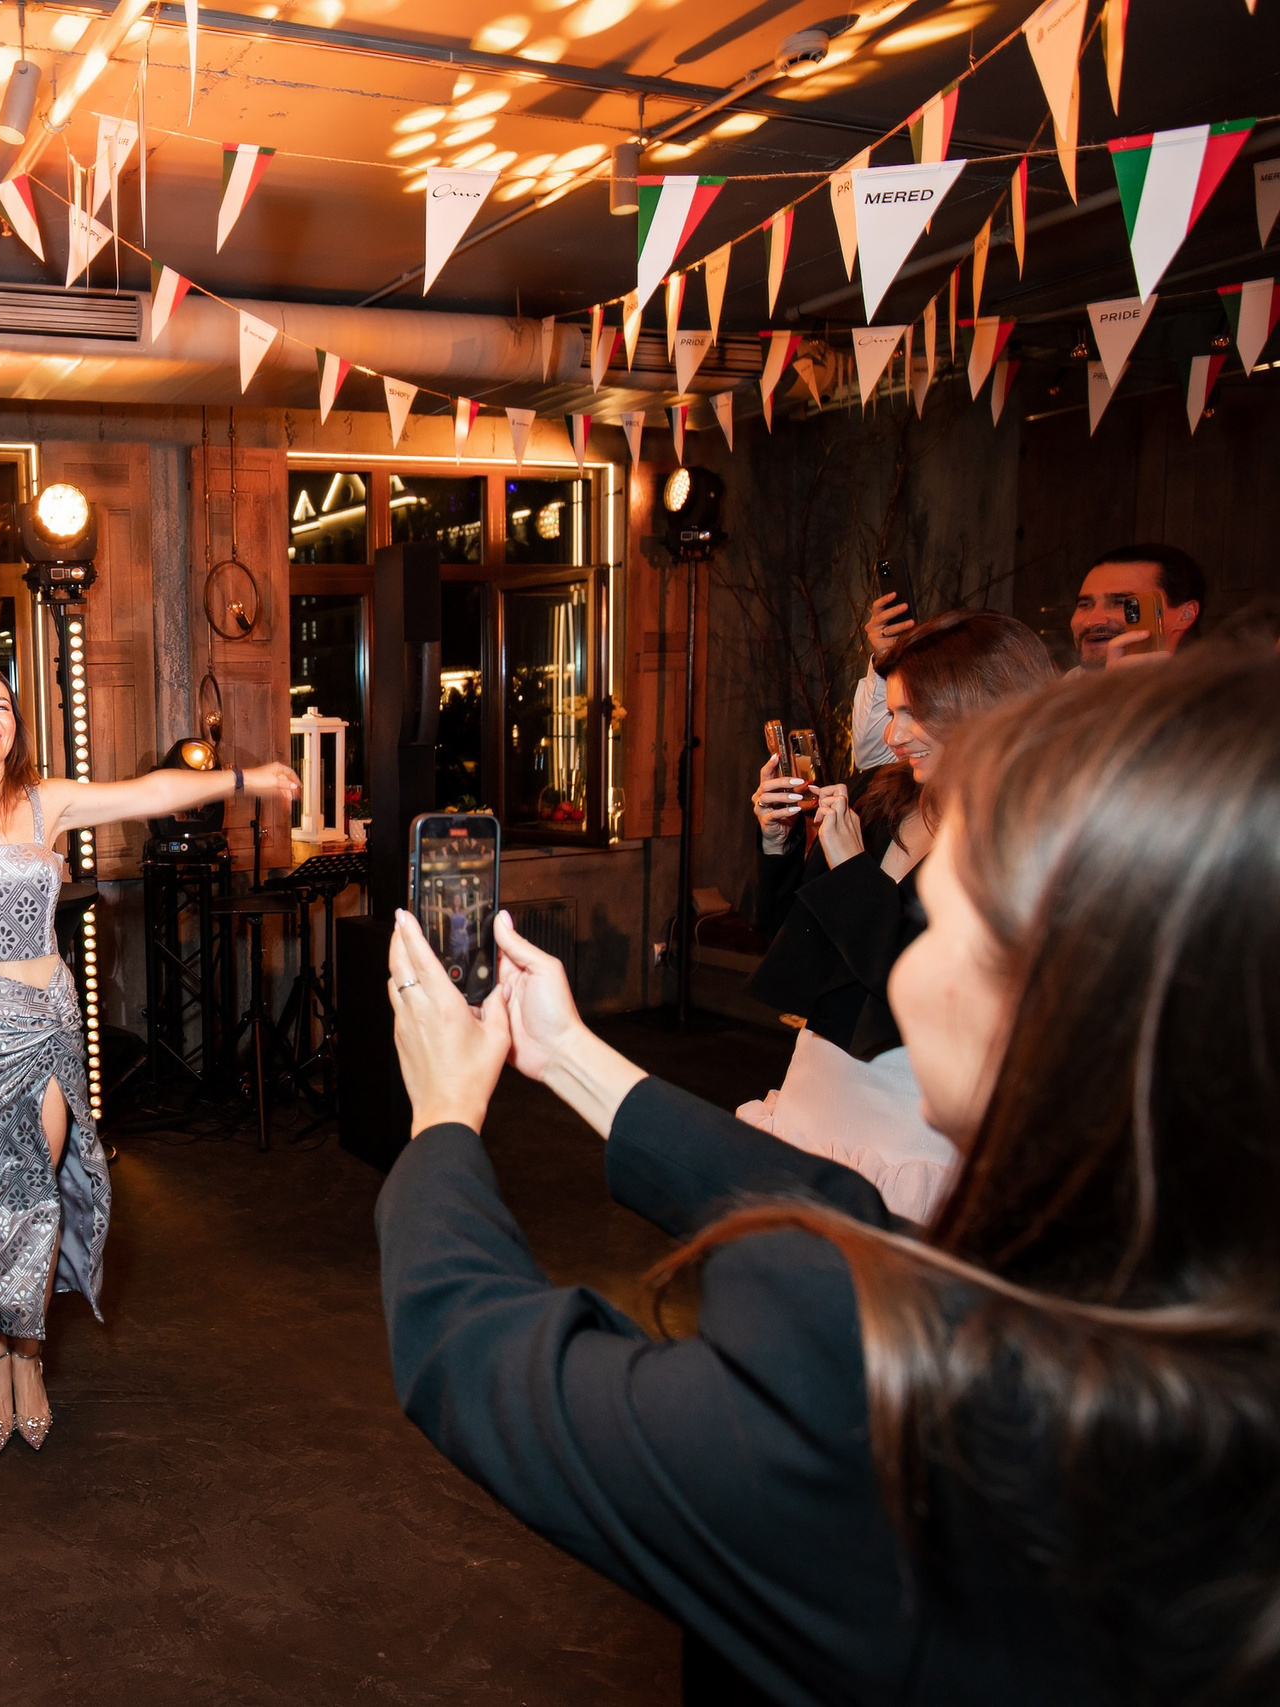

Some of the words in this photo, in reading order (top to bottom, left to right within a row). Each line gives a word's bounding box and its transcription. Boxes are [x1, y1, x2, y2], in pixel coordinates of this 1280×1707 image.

[1260, 171, 1280, 182] MER
[836, 179, 853, 197] PRI
[864, 188, 935, 205] MERED
[1099, 308, 1141, 323] PRIDE
[680, 338, 706, 346] PRIDE
[388, 387, 411, 401] SHIFT
